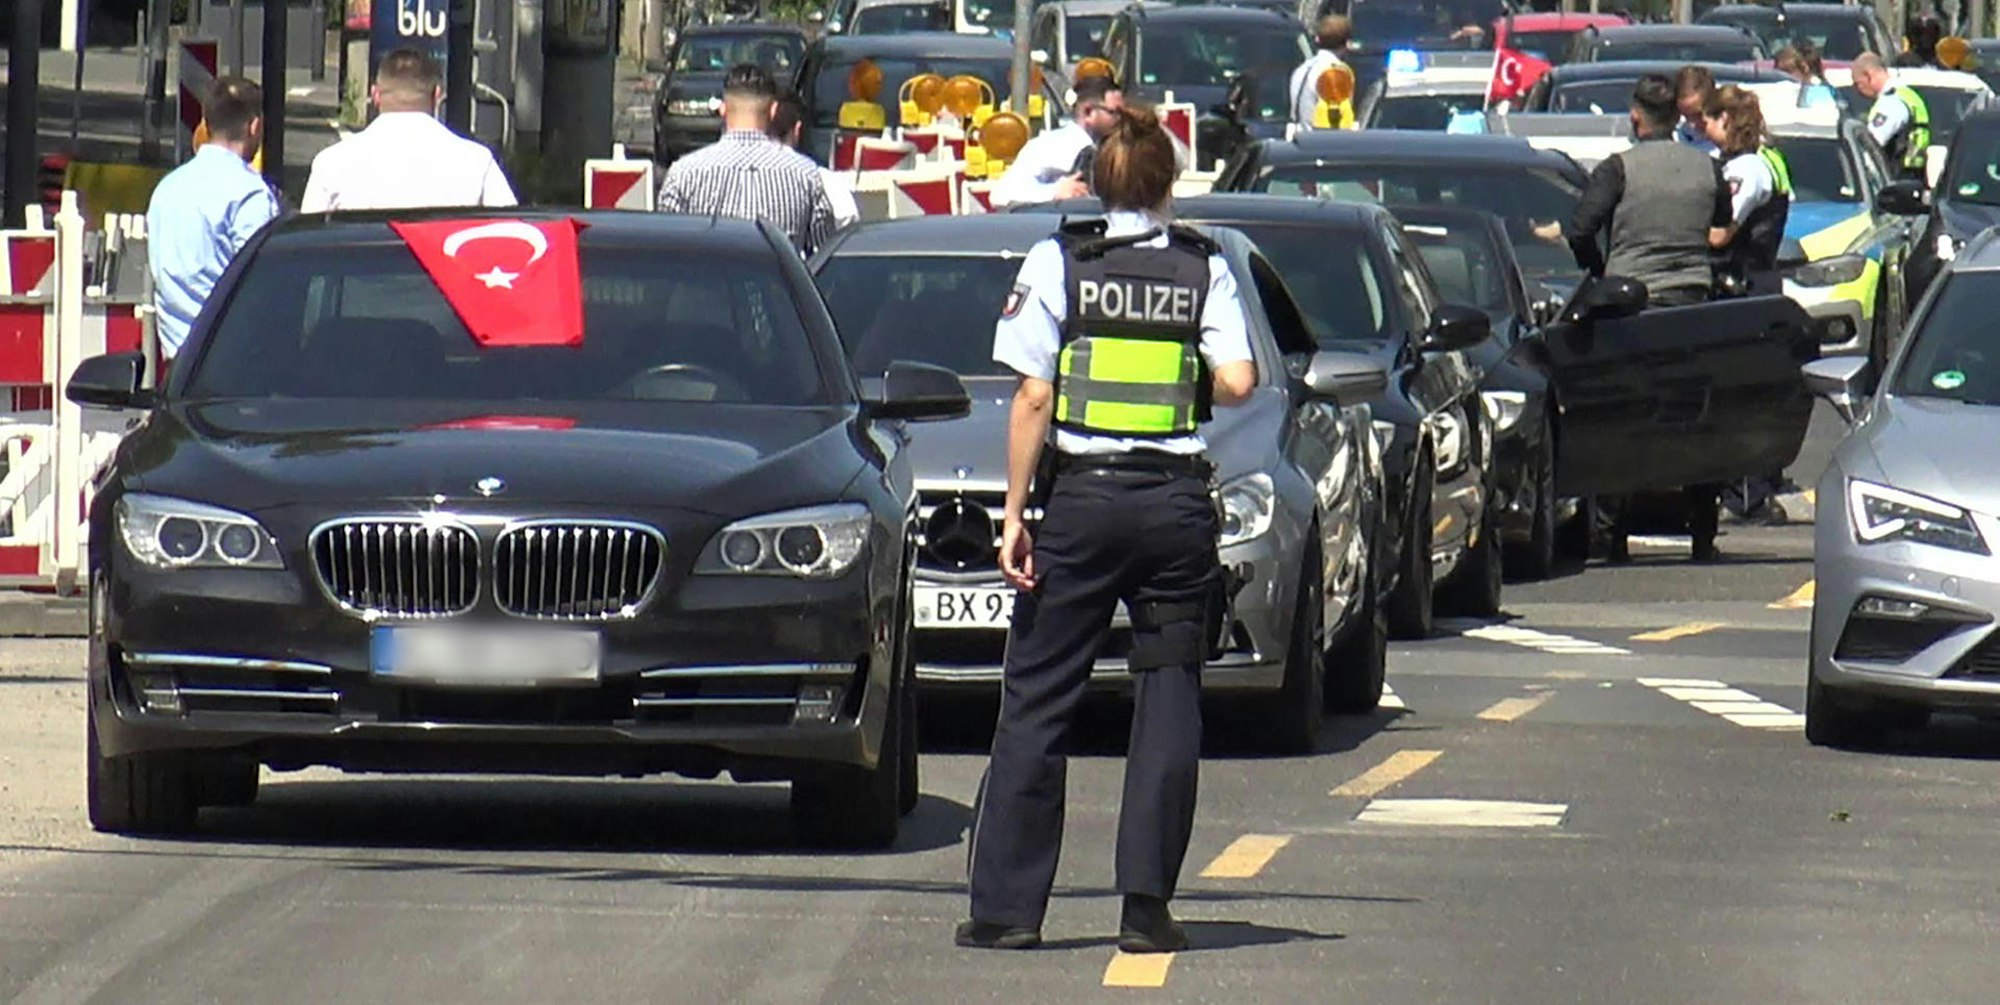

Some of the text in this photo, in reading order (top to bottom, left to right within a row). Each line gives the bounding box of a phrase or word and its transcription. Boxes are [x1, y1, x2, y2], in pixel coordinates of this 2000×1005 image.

[397, 0, 447, 37] blu
[1078, 279, 1199, 322] POLIZEI
[937, 591, 976, 622] BX
